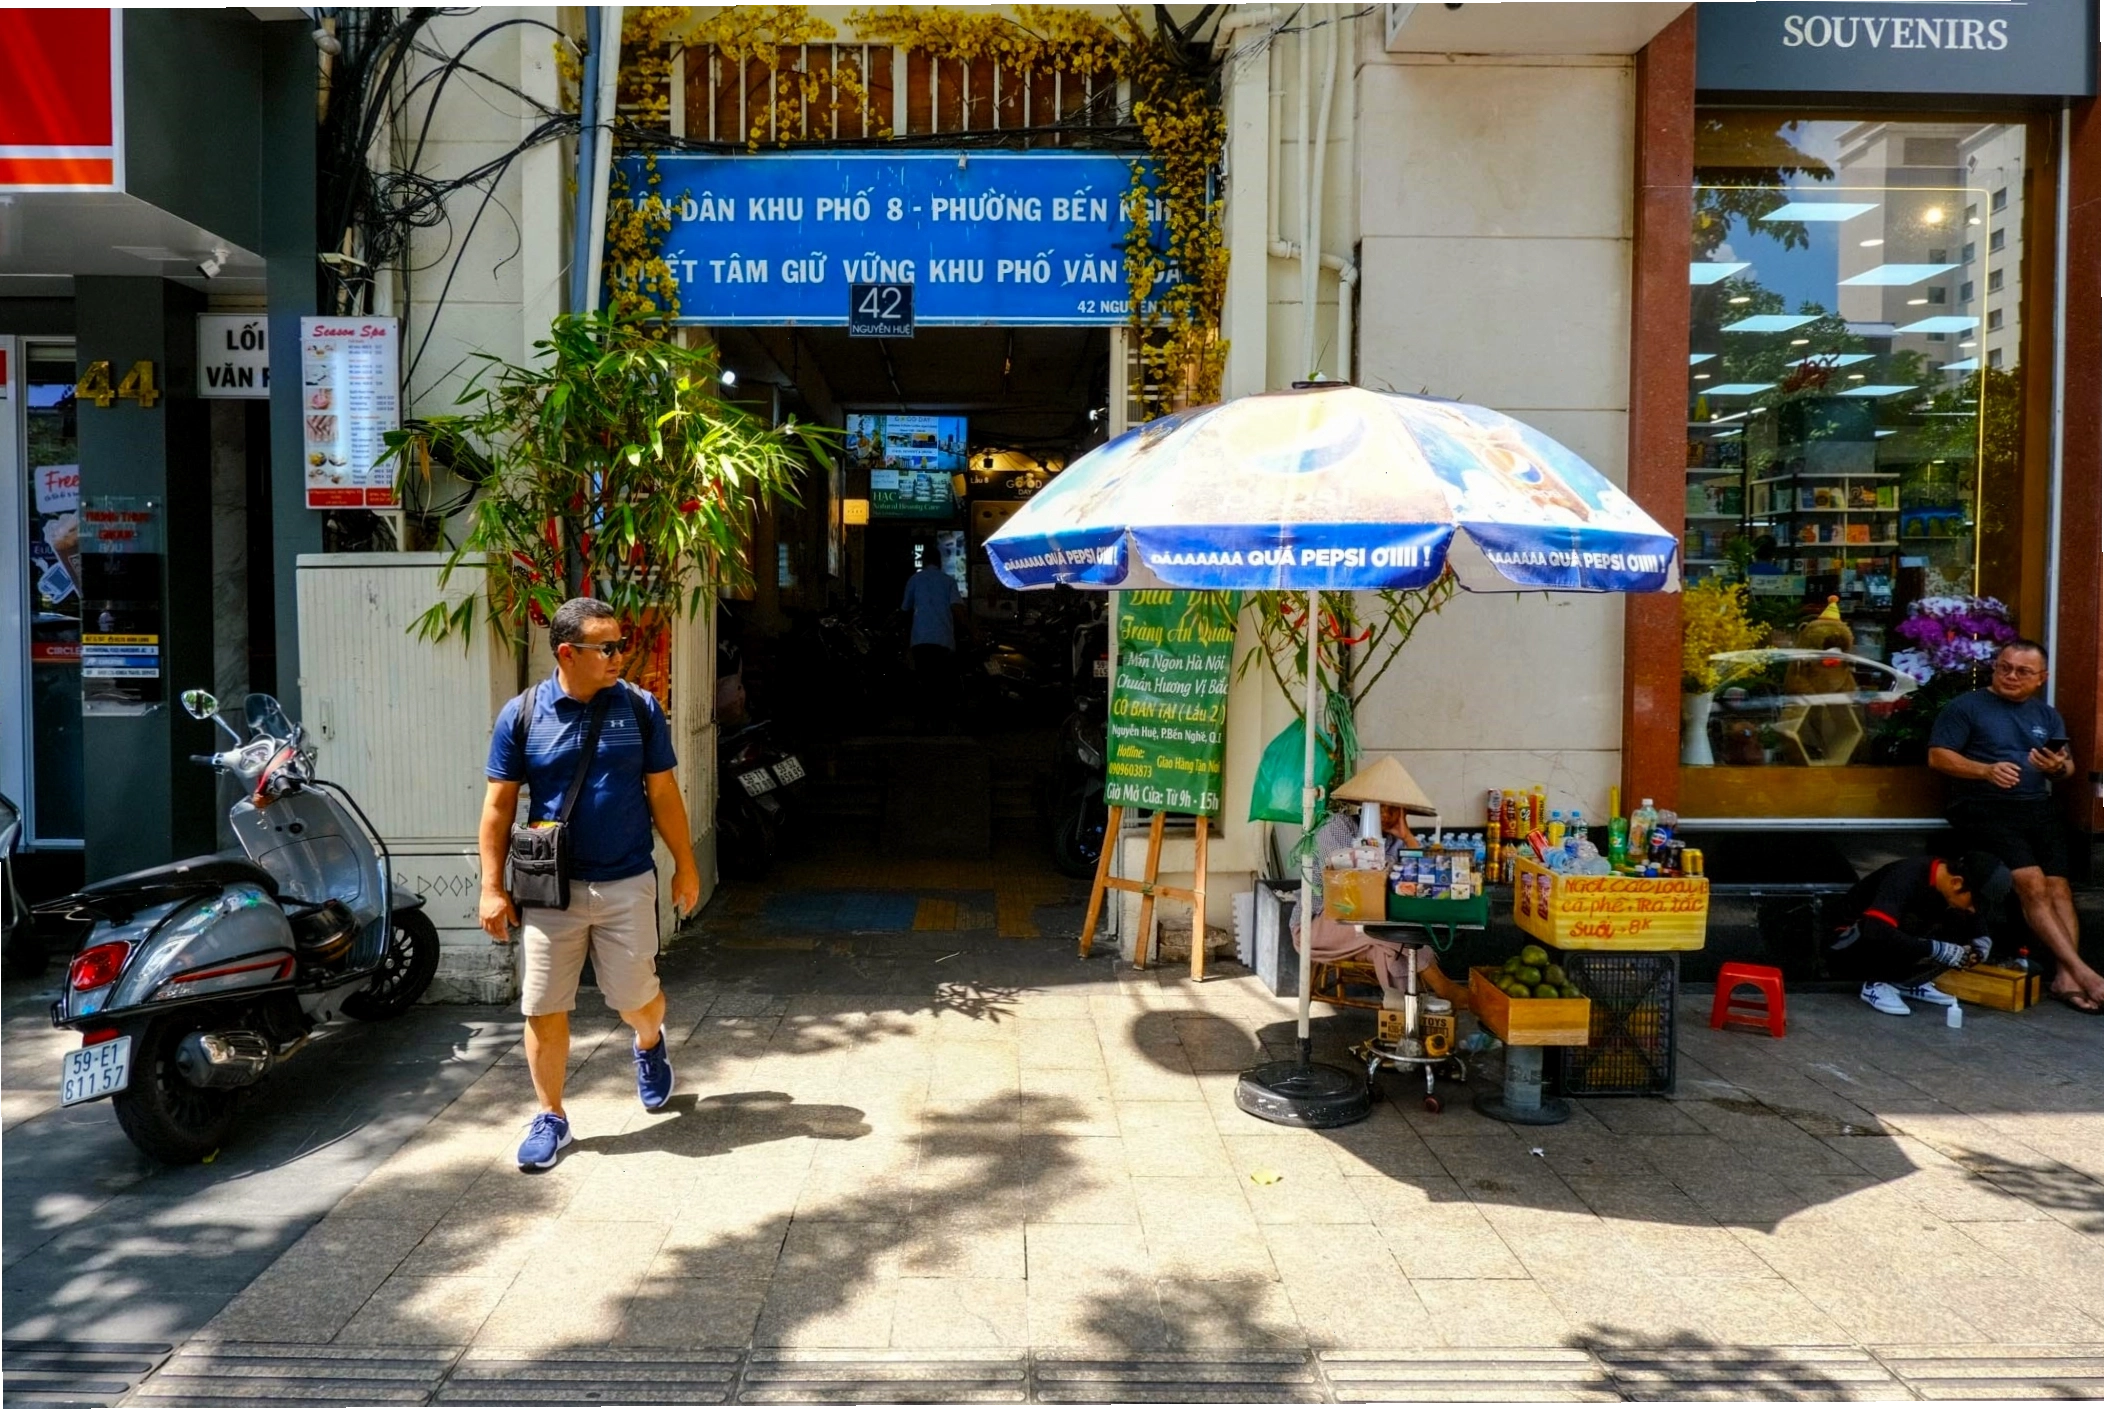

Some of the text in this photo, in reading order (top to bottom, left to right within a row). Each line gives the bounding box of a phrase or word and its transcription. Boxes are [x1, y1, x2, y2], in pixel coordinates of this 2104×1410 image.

[1783, 15, 2008, 50] SOUVENIRS
[682, 191, 735, 221] DÂN
[749, 198, 803, 221] KHU
[817, 187, 875, 221] PHỐ
[887, 198, 904, 221] 8
[932, 188, 1041, 221] PHƯỜNG
[1053, 186, 1107, 221] BẾN
[710, 253, 768, 283] TÂM
[782, 251, 828, 283] GIỮ
[843, 251, 914, 283] VỮNG
[930, 260, 984, 283] KHU
[998, 249, 1054, 283] PHỐ
[1064, 254, 1117, 283] VĂN
[859, 287, 902, 318] 42
[1077, 301, 1096, 313] 42
[227, 322, 264, 350] LỐI
[313, 325, 386, 338] Season Spa
[852, 322, 910, 334] NGUYỄN HUỆ
[75, 361, 159, 407] 44
[206, 363, 253, 388] VĂN
[44, 471, 80, 492] Free
[1065, 547, 1096, 564] PEPSI
[1247, 546, 1297, 566] QUÁ
[1301, 549, 1365, 567] PEPSI
[1549, 549, 1582, 567] QUÁ
[1584, 552, 1626, 572] PEPSI
[1152, 654, 1183, 673] Ngon
[1186, 654, 1203, 671] Hà
[1205, 655, 1226, 673] Nội
[1154, 677, 1192, 697] Hương
[1114, 694, 1129, 715] CÓ
[1158, 703, 1177, 723] TẠI
[1112, 724, 1139, 738] Nguyễn
[1117, 744, 1145, 759] Hotline:
[1109, 762, 1153, 778] 0909603873
[1157, 755, 1173, 769] Giao
[1175, 756, 1194, 773] Hàng
[1107, 782, 1121, 799] Giờ
[1123, 783, 1140, 803] Mở
[1166, 788, 1178, 806] Từ
[1180, 790, 1191, 808] 9h
[1199, 791, 1219, 810] 15h
[1423, 1017, 1447, 1027] TOYS
[73, 1043, 118, 1075] 59-E1
